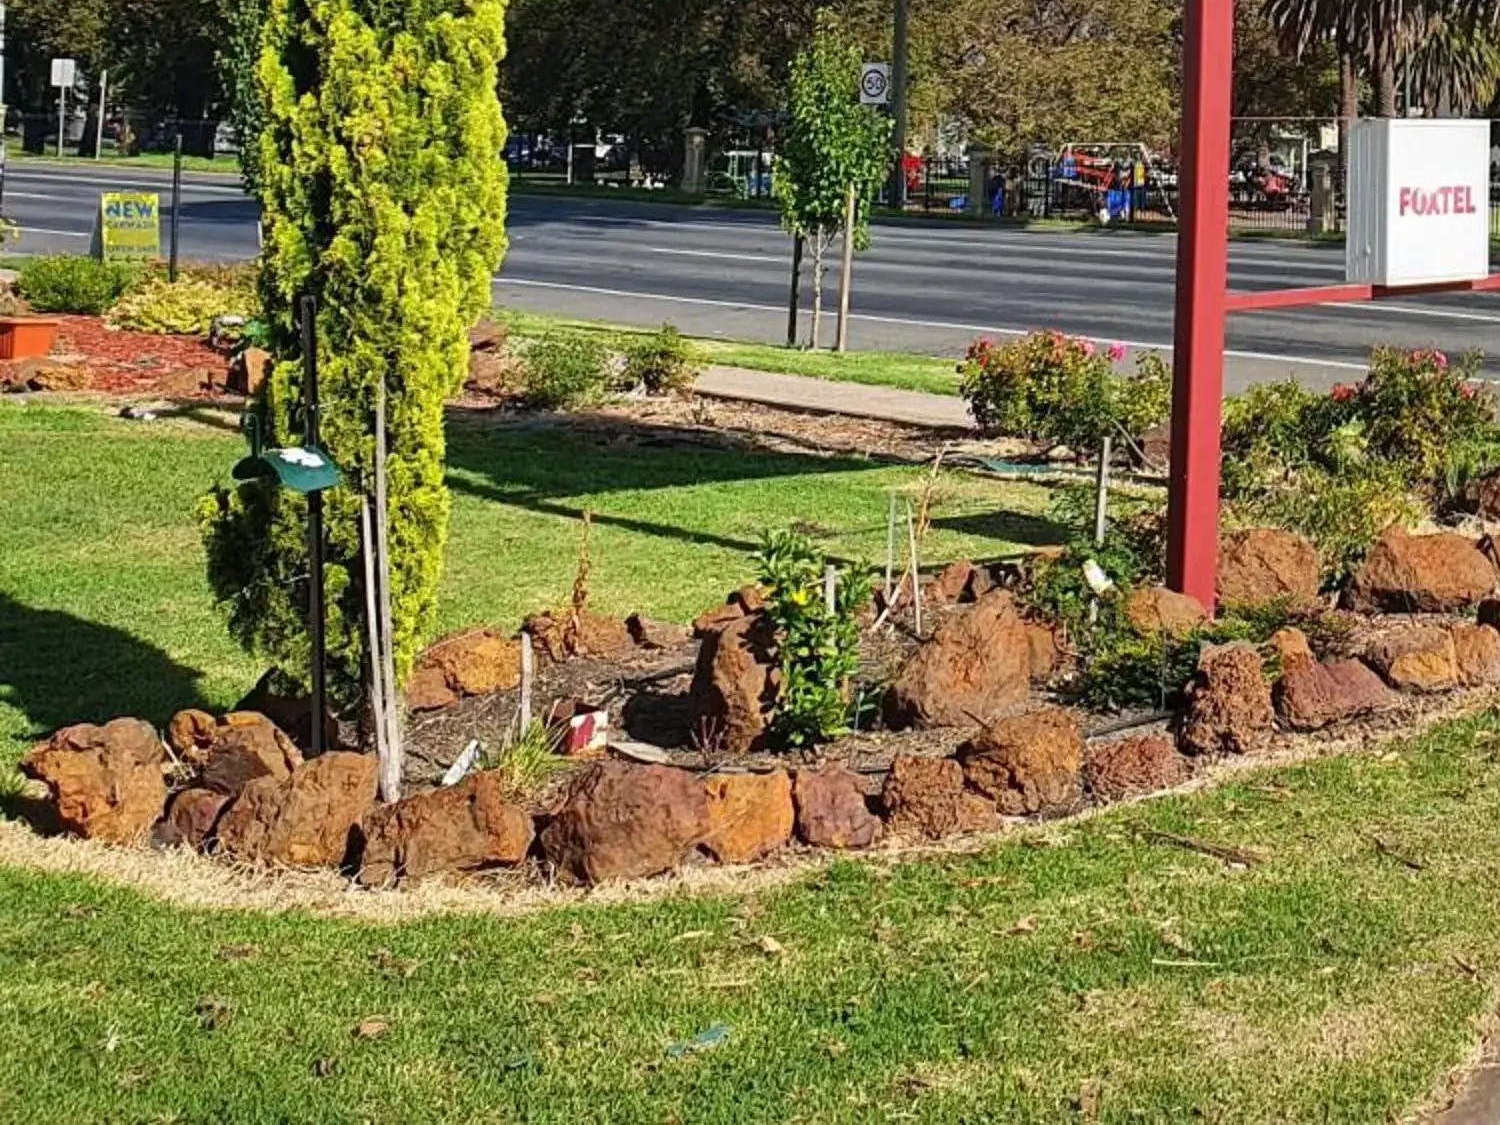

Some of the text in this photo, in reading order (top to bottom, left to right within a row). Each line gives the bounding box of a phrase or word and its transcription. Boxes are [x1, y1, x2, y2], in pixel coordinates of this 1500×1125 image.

[867, 76, 883, 90] 50
[1399, 185, 1476, 216] FOXTEL
[106, 201, 154, 218] NEW
